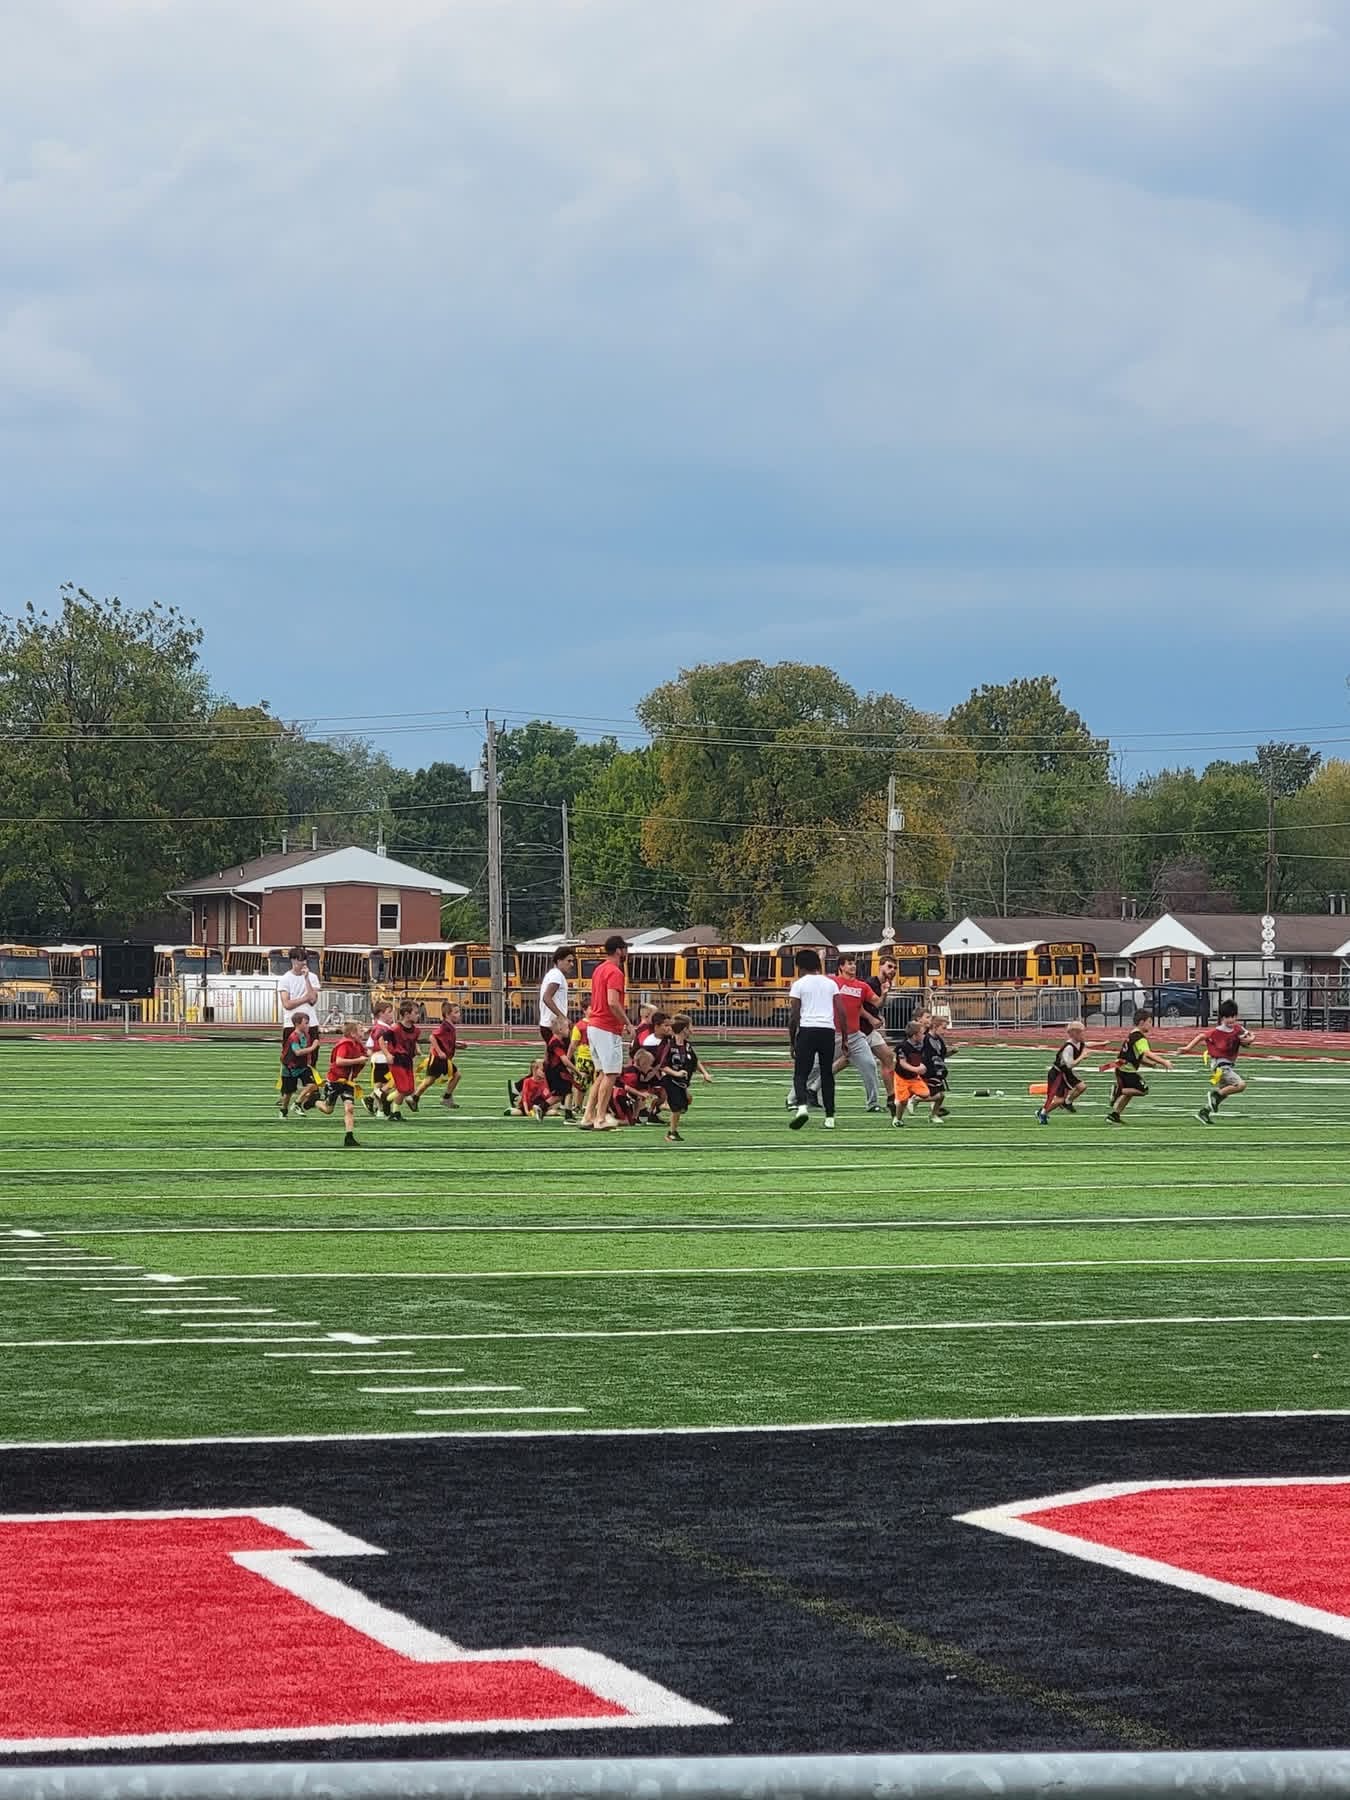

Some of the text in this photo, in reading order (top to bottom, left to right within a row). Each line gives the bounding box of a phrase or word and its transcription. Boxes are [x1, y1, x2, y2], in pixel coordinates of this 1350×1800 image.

[894, 946, 927, 955] SCHOOL BUS
[1051, 945, 1070, 954] SCHOOL
